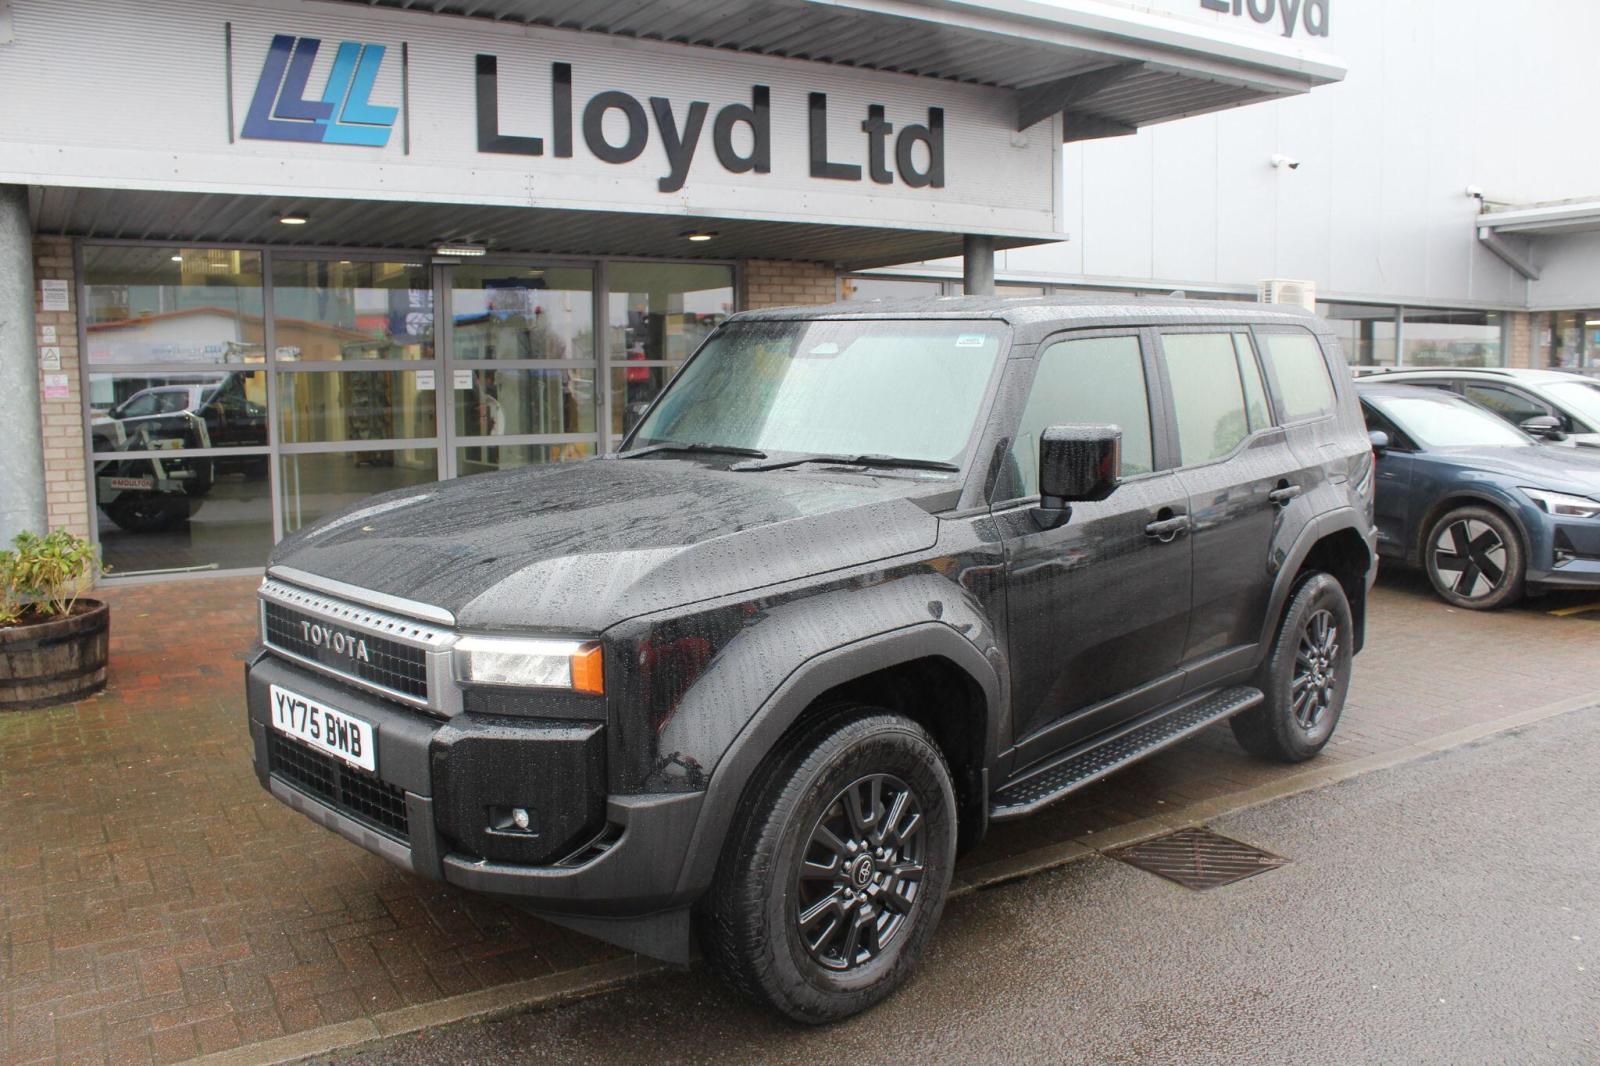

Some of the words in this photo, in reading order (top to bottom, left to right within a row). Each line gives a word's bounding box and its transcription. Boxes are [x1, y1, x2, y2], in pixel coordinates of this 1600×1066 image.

[1199, 0, 1329, 38] oyd
[475, 53, 770, 192] Lloyd
[809, 92, 945, 188] Ltd
[300, 620, 369, 662] TOYOTA
[275, 691, 321, 739] YY75
[324, 712, 362, 758] BWB
